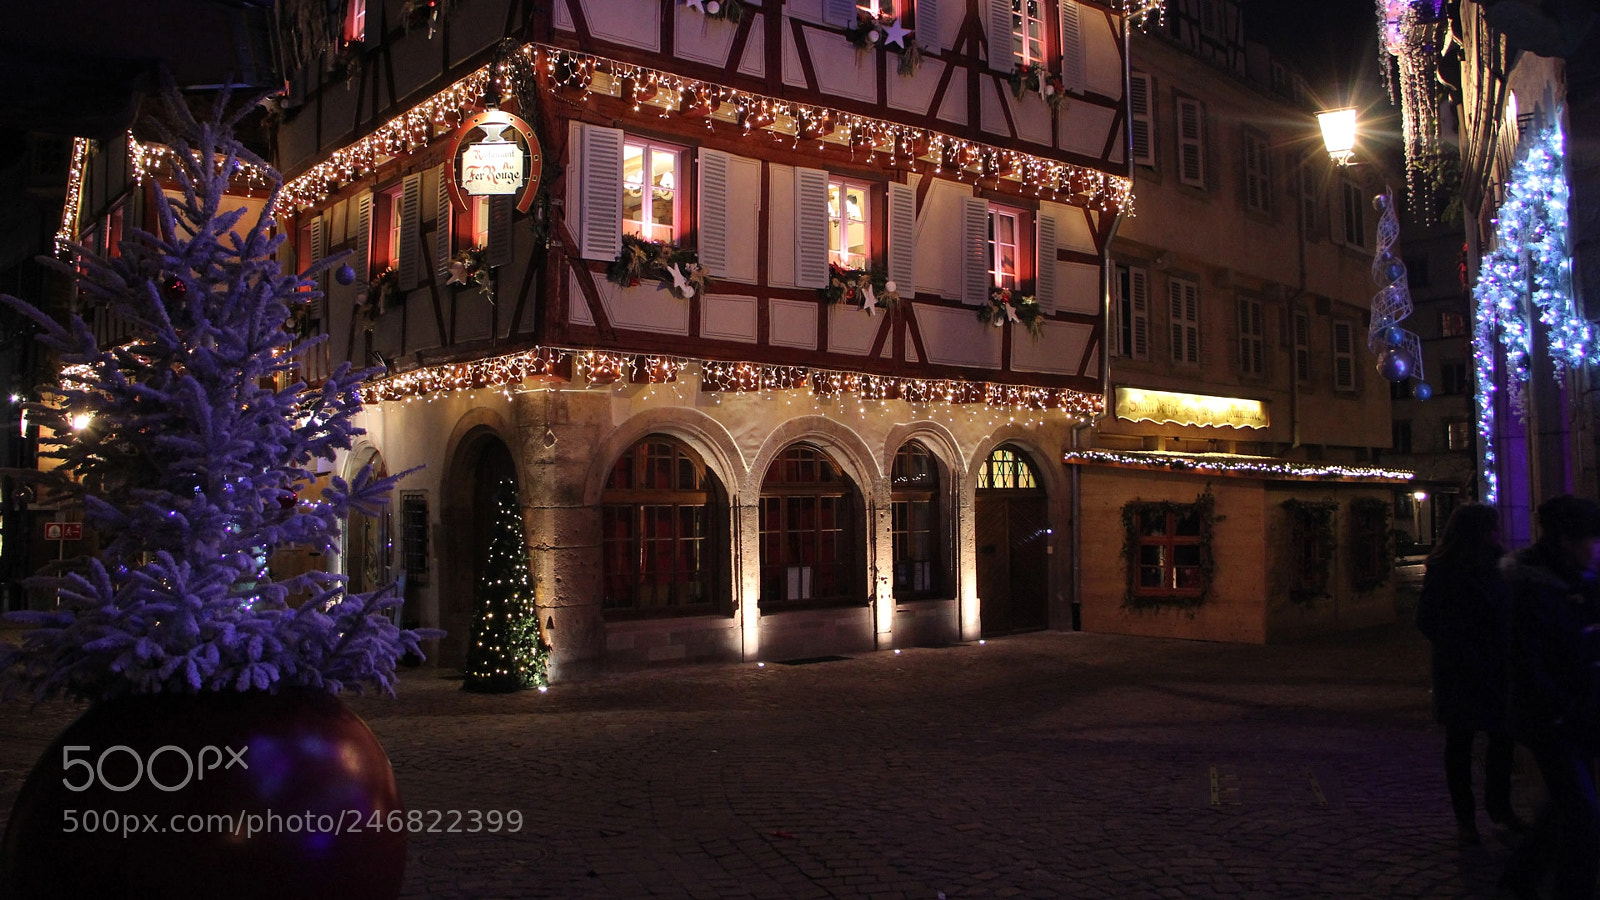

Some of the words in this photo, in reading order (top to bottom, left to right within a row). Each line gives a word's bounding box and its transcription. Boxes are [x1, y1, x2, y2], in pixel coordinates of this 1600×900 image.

[473, 149, 515, 160] Restaurant
[502, 161, 514, 170] Au
[465, 165, 485, 186] Fer
[483, 165, 520, 185] Rouge
